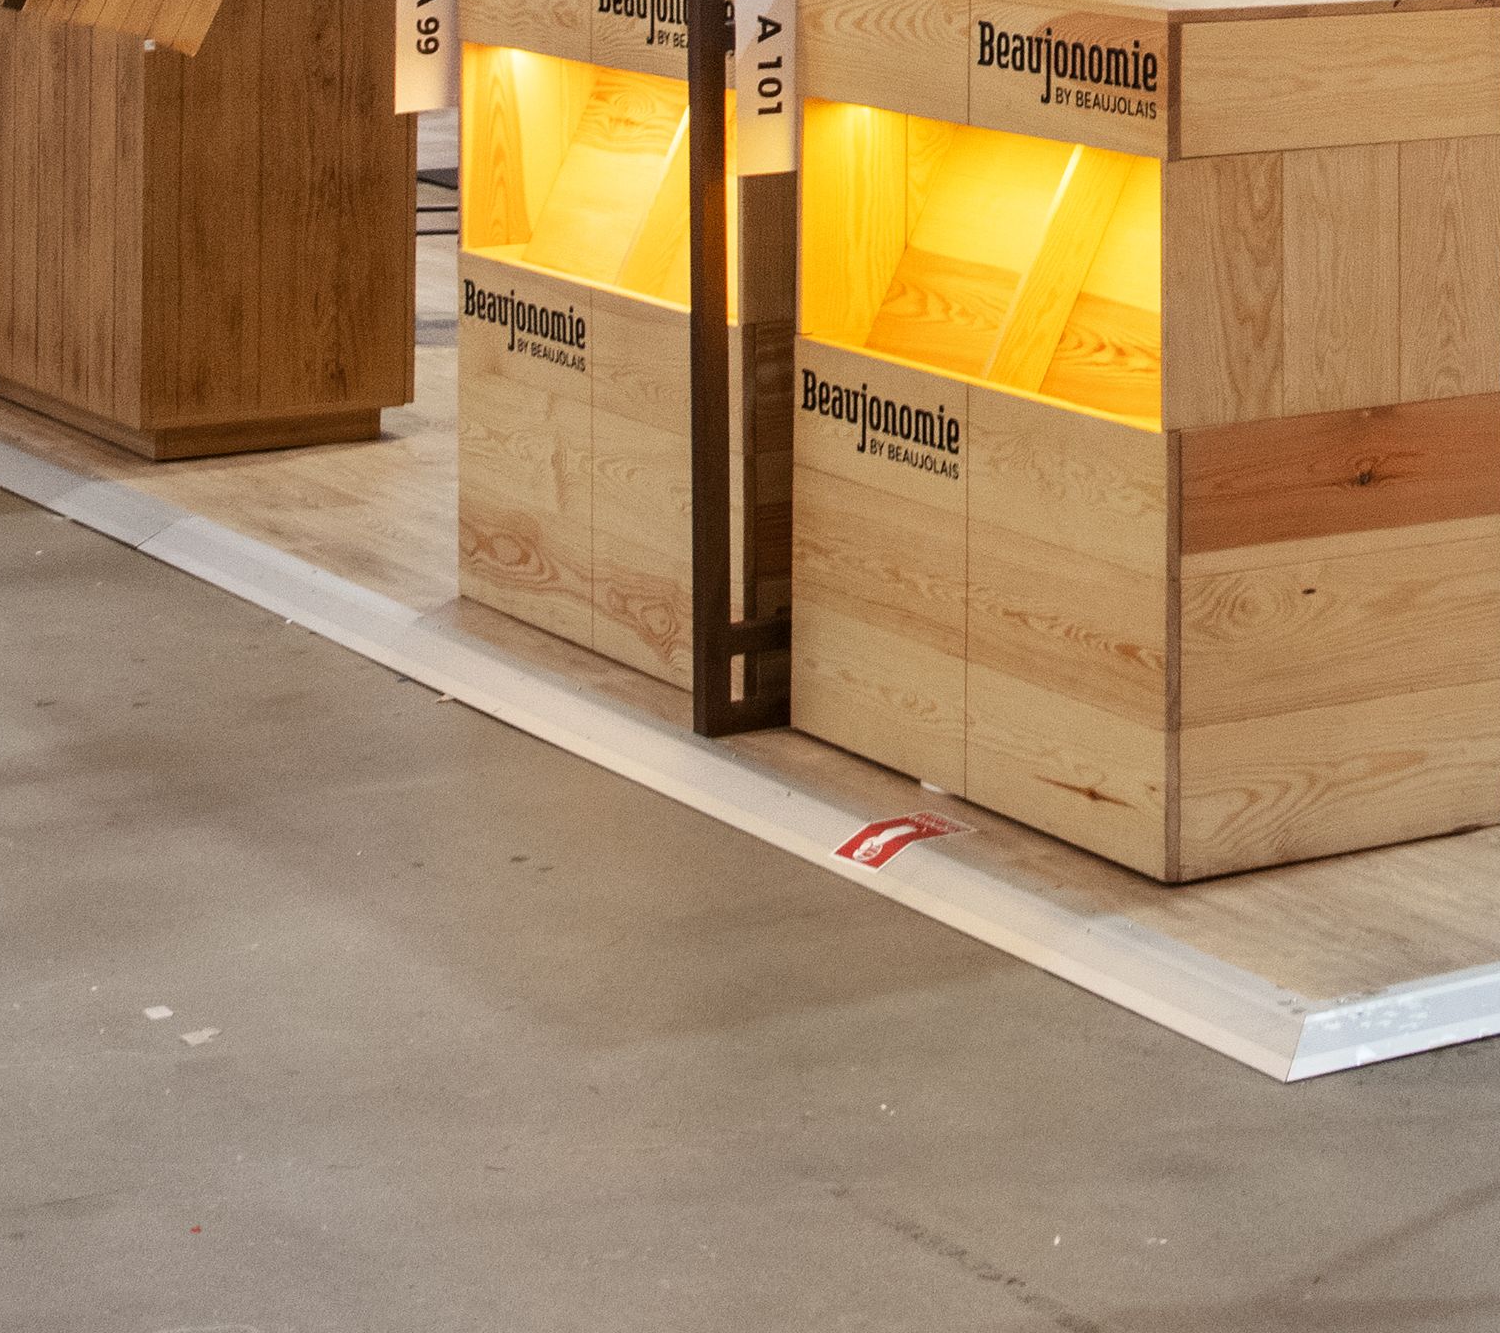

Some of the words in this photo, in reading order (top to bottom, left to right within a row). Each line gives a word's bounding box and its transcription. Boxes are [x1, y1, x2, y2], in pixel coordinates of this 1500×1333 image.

[415, 18, 440, 57] 99
[757, 15, 782, 44] A
[978, 21, 1158, 105] Beaujonomie
[757, 56, 782, 116] 101
[1055, 87, 1071, 107] BY
[1074, 90, 1158, 120] BEAUJOLAIS
[464, 279, 586, 353] Beaujonomie
[518, 337, 530, 355] BY
[531, 340, 586, 374] BEAUJOLAIS
[801, 369, 960, 454] Beaujonomie
[870, 438, 886, 457] BY
[888, 441, 960, 481] BEAUJOLAIS
